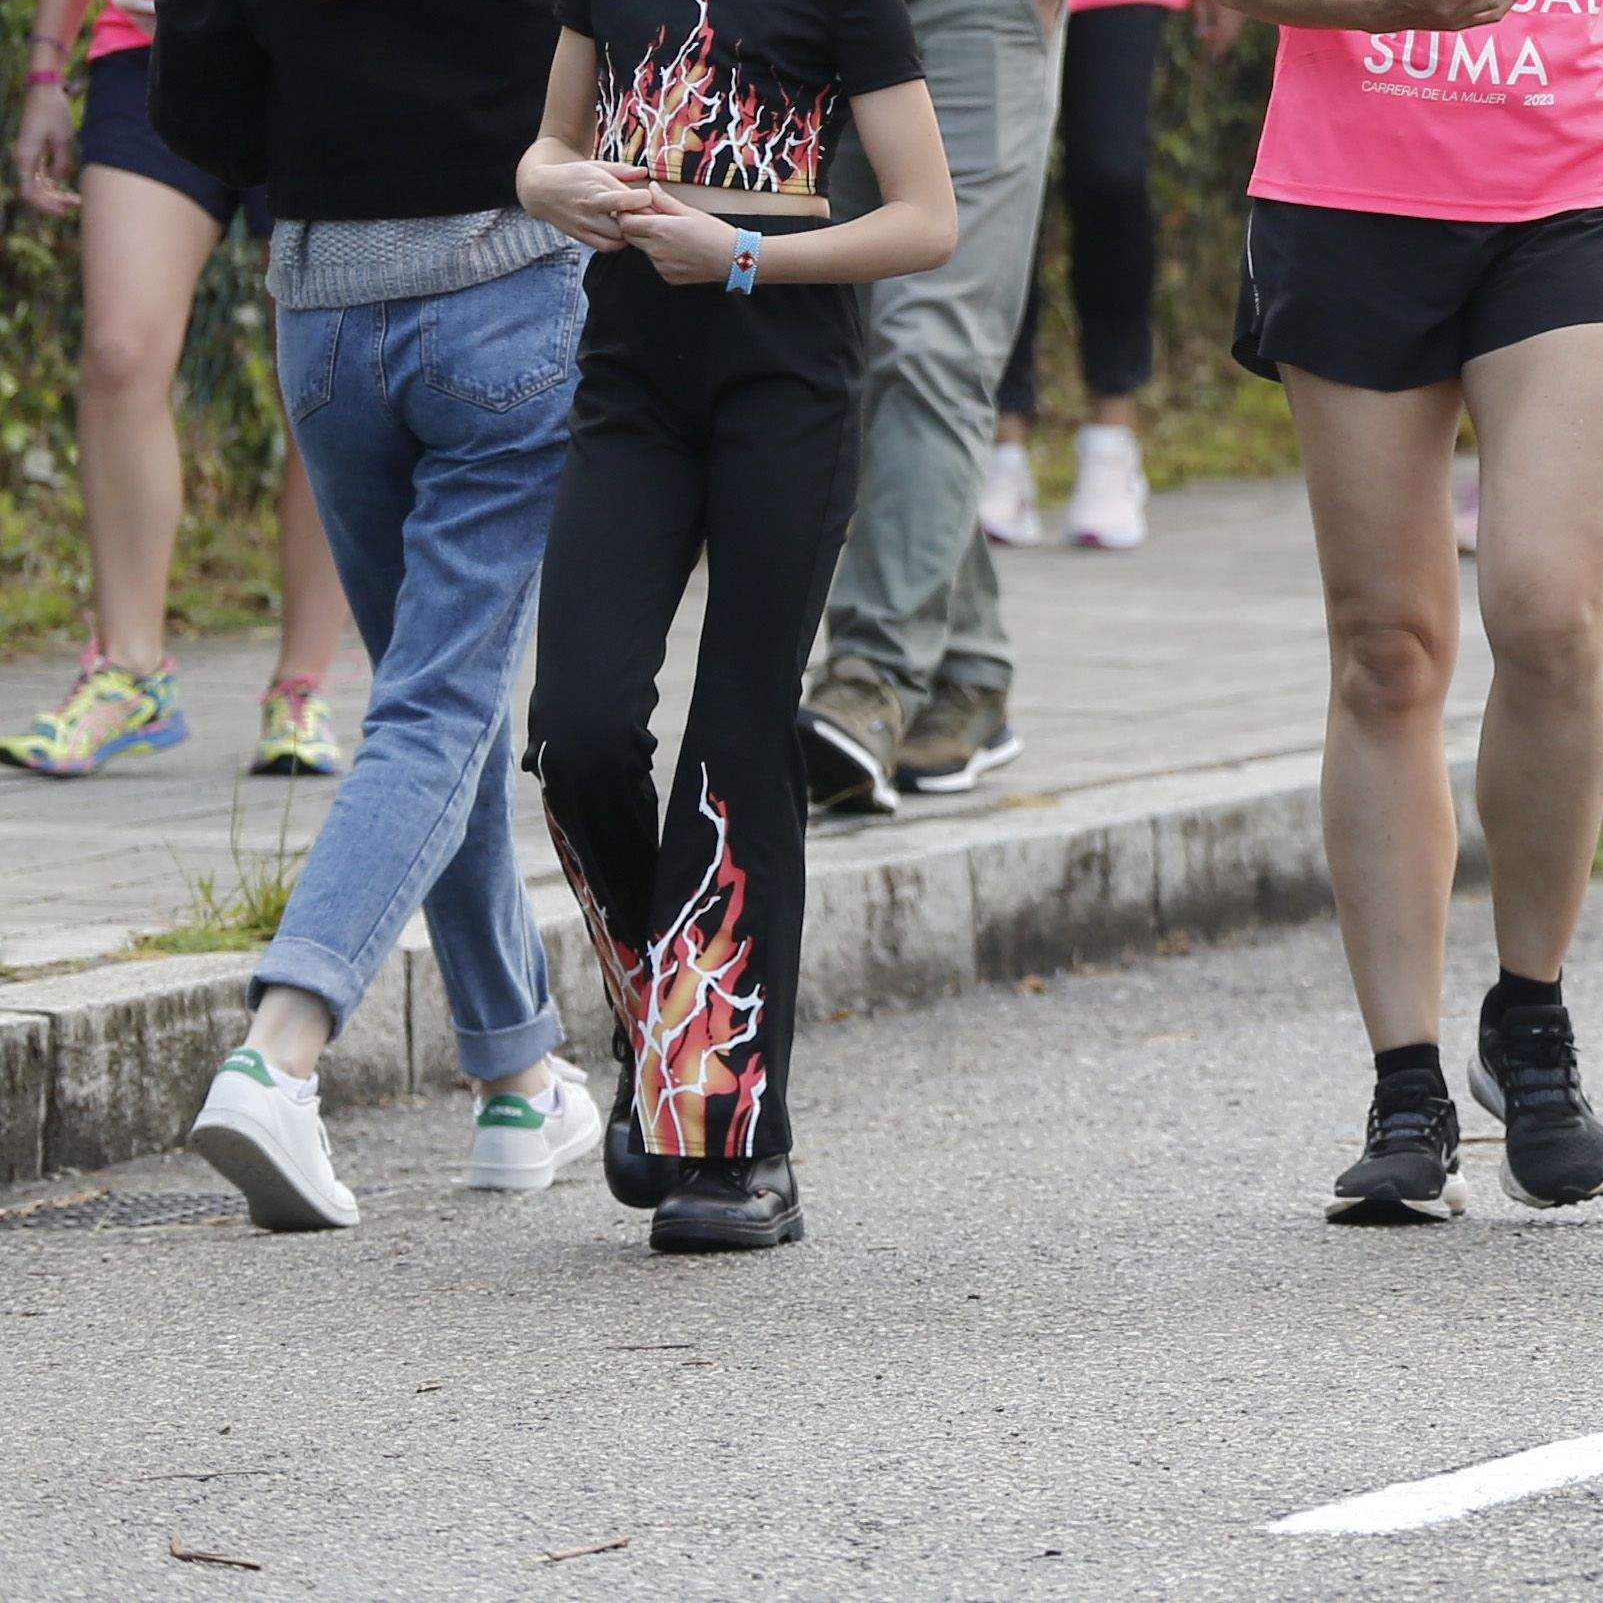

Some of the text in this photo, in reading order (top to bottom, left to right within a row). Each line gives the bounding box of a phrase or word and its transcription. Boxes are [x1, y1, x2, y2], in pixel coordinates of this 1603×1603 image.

[1363, 30, 1549, 87] SUMA
[1361, 80, 1555, 107] CARRERA DE LA MUJER 2023
